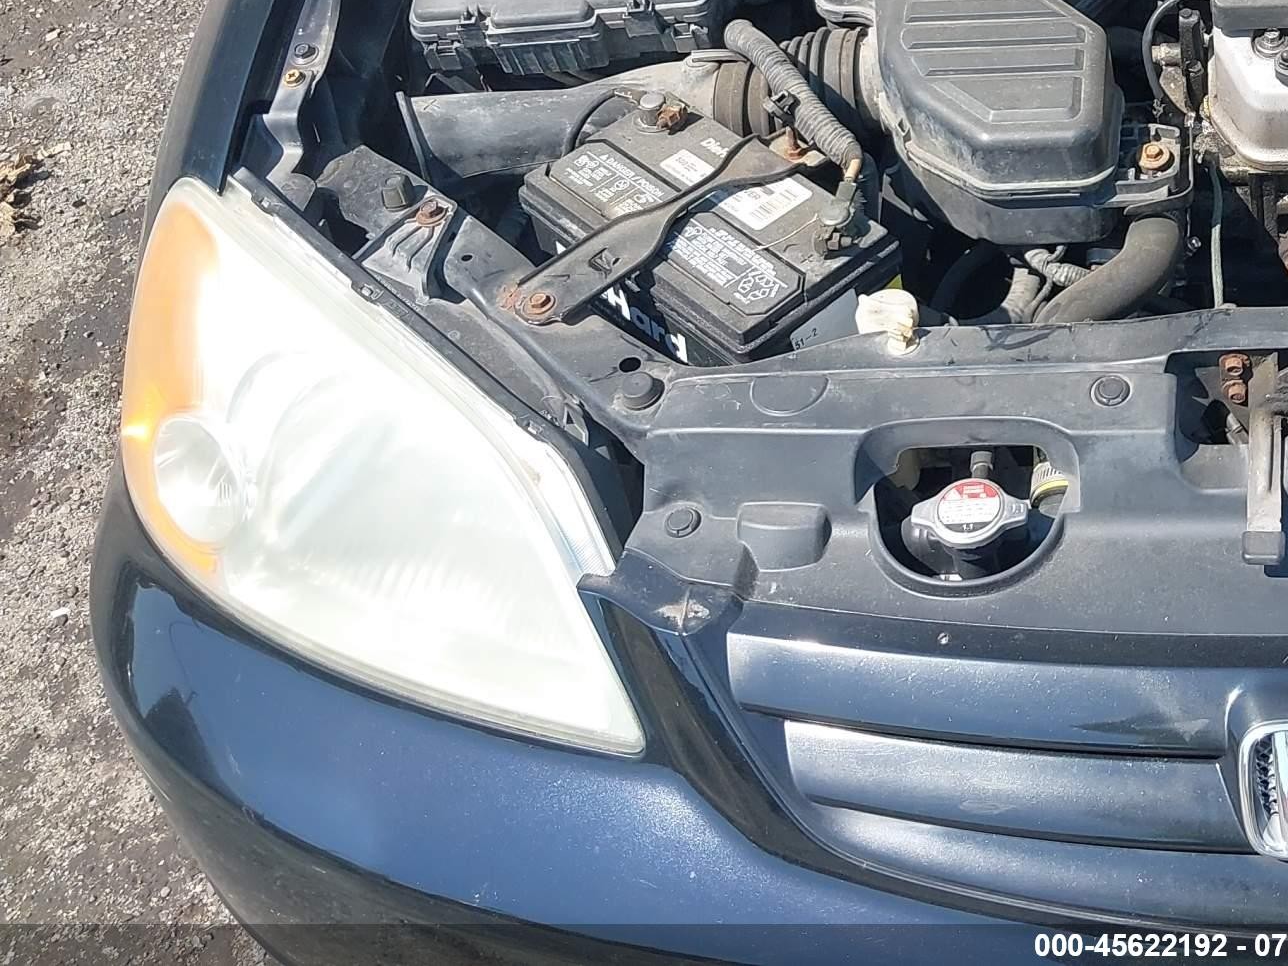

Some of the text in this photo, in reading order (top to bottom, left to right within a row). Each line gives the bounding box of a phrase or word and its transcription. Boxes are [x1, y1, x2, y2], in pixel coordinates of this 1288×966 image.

[606, 157, 636, 177] DANGER
[636, 178, 664, 197] POISON
[601, 286, 688, 364] Hard
